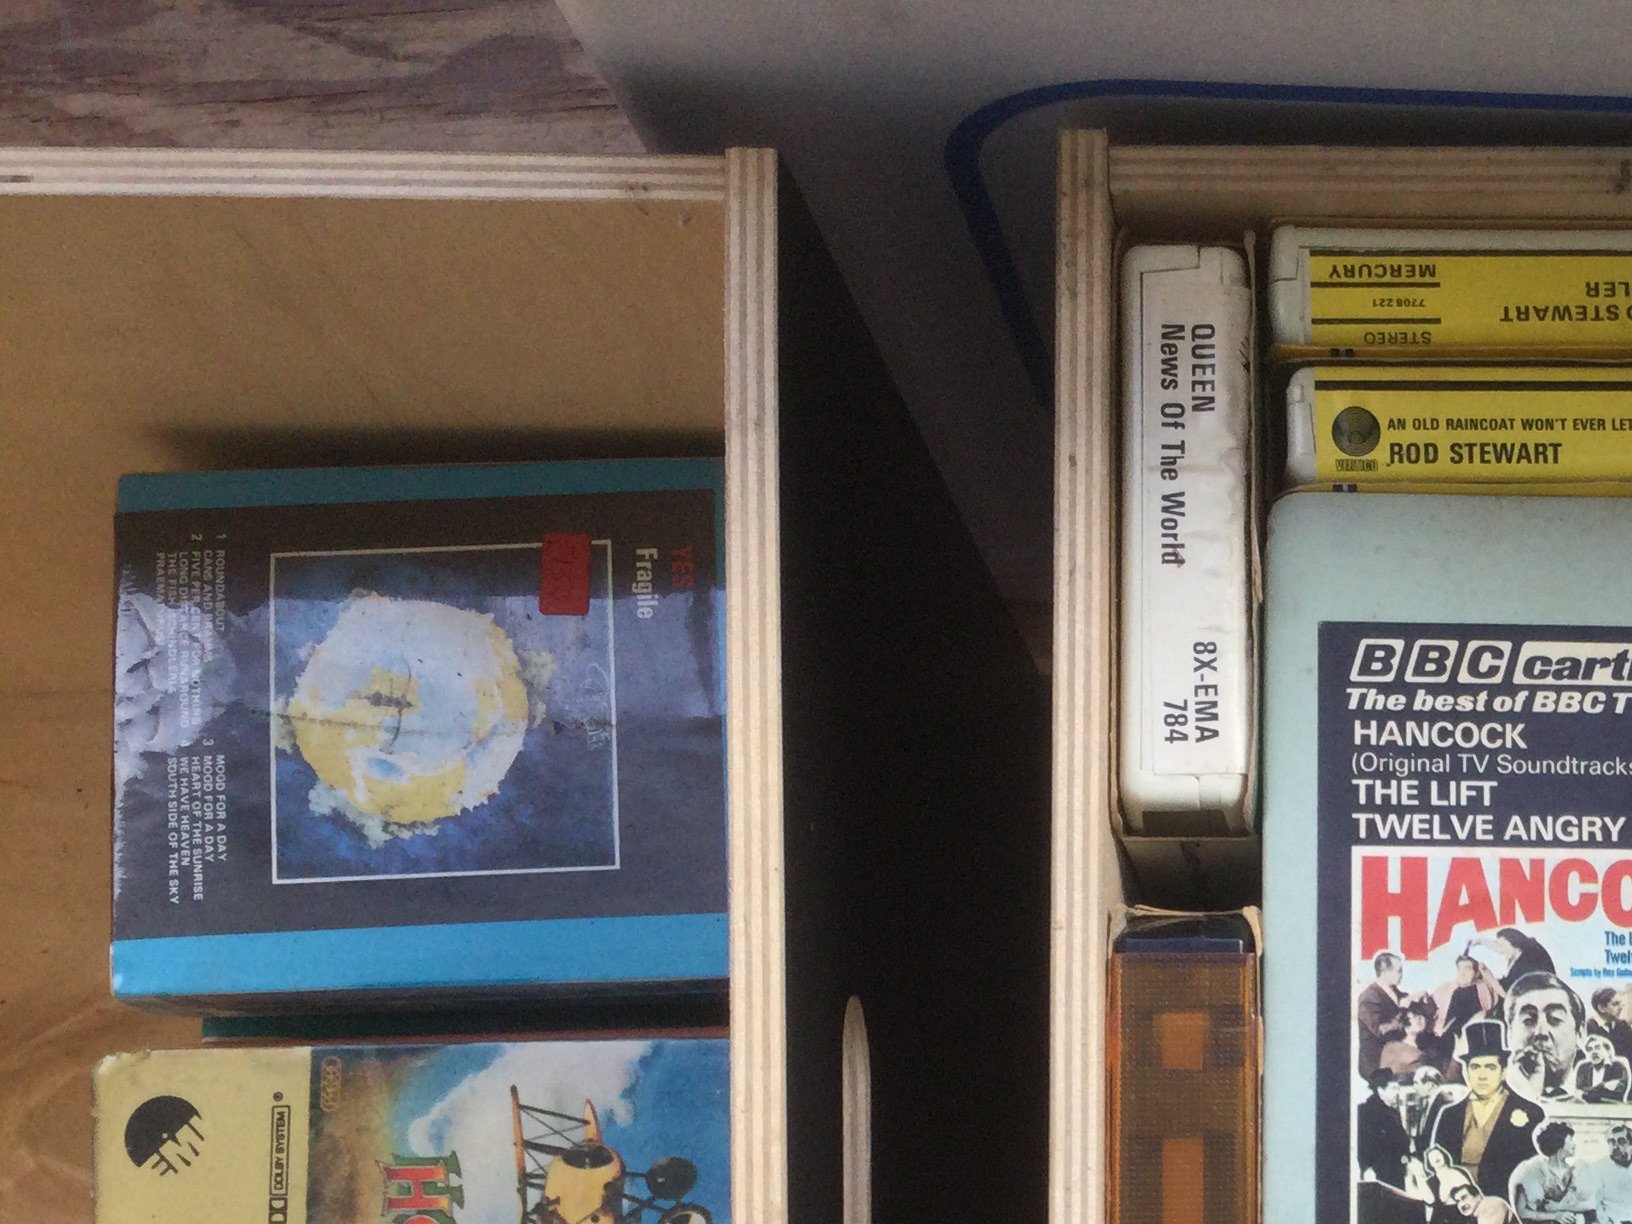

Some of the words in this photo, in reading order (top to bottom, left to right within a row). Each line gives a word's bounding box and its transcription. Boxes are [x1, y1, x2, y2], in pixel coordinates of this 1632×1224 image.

[1328, 263, 1437, 279] MERCURY
[1499, 304, 1621, 322] STEWART
[1160, 323, 1186, 391] News
[1190, 323, 1216, 413] QUEEN
[1160, 397, 1186, 432] Of
[1386, 417, 1407, 431] AN
[1411, 417, 1440, 431] OLD
[1445, 417, 1516, 431] RAINCOAT
[1520, 417, 1568, 431] WON'T
[1572, 418, 1607, 431] EVER
[1160, 438, 1186, 483] The
[1388, 442, 1440, 465] ROD
[1449, 442, 1564, 465] STEWART
[1160, 489, 1186, 567] World
[671, 544, 695, 588] YES
[631, 547, 659, 620] Fragile
[1352, 640, 1512, 683] BBC
[1163, 698, 1189, 746] 784
[1353, 720, 1528, 749] HANCOCK
[167, 757, 179, 799] SOUTH
[190, 755, 202, 798] HEART
[1351, 779, 1420, 806] THE
[1430, 781, 1499, 807] LIFT
[167, 800, 179, 829] SIDE
[191, 800, 202, 818] OF
[167, 831, 179, 850] OF
[191, 820, 203, 846] THE
[1351, 814, 1495, 842] TWELVE
[1503, 815, 1627, 844] ANGRY
[168, 852, 180, 876] THE
[192, 847, 204, 901] SUNRISE
[168, 878, 180, 905] SKY
